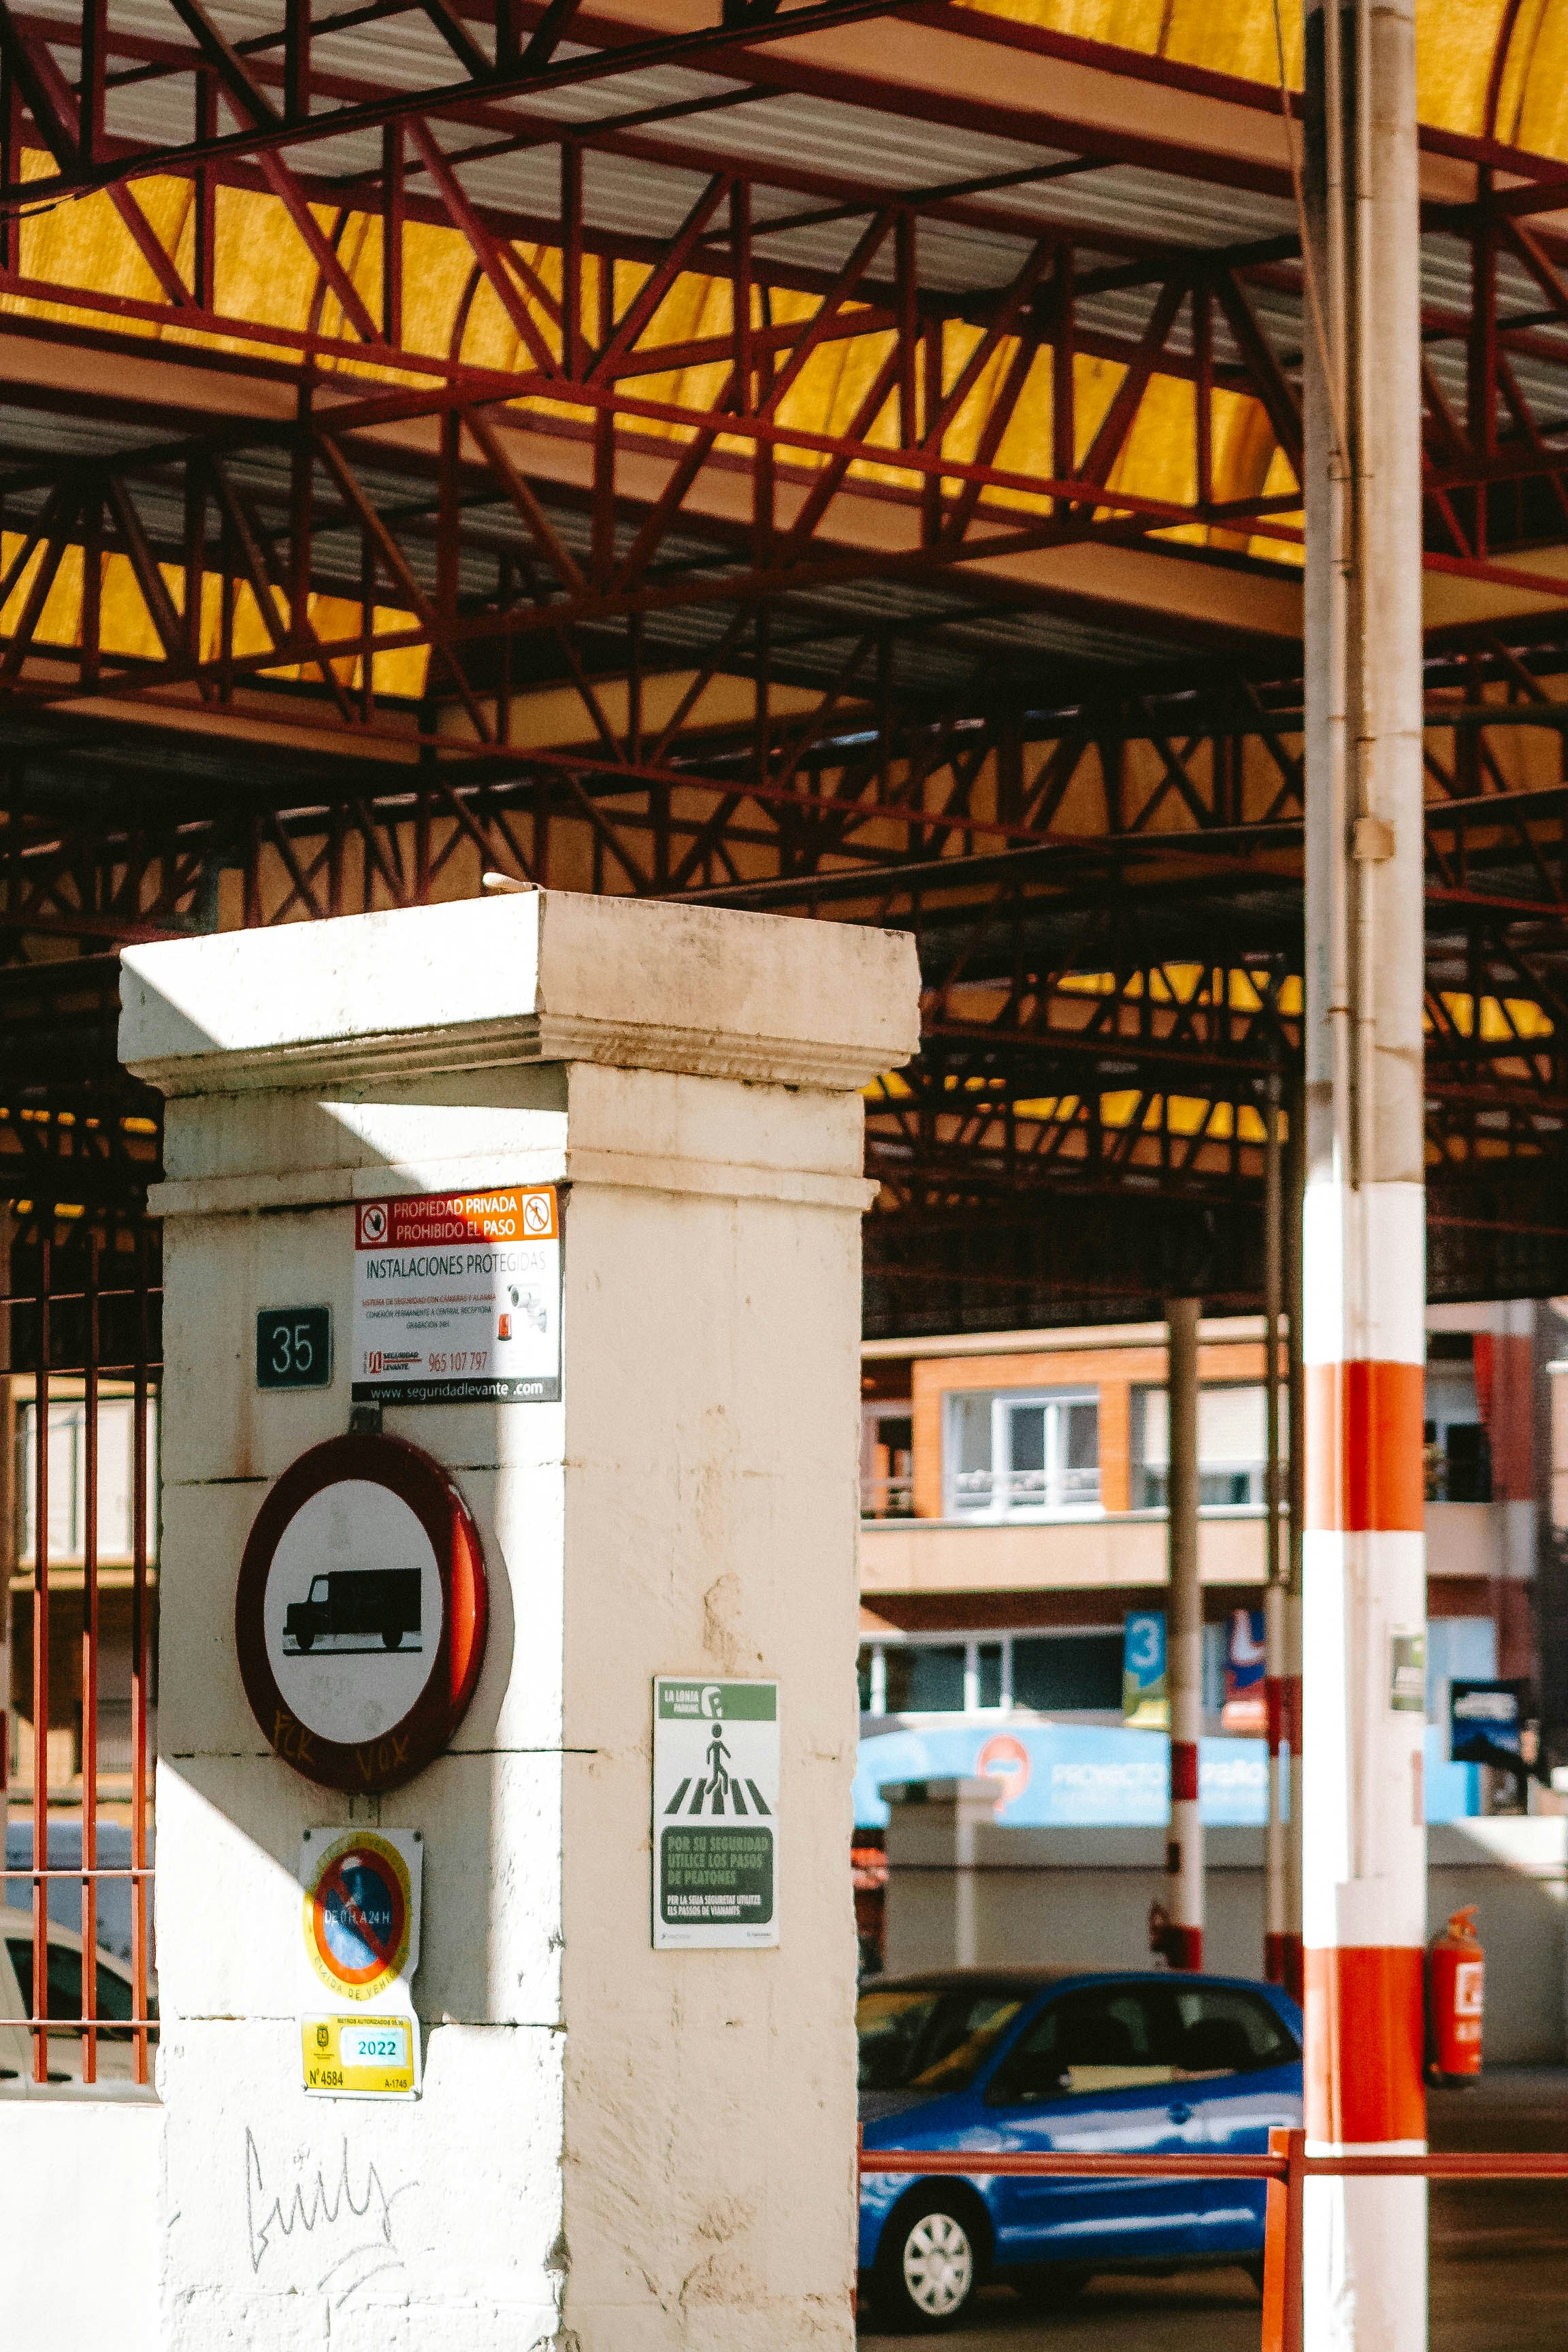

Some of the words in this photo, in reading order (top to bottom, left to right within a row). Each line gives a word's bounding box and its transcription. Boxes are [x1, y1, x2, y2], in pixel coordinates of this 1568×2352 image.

[394, 1199, 463, 1218] PROPIEDAD
[466, 1196, 518, 1214] PRIVADA
[397, 1222, 464, 1240] PROHIBIDO
[467, 1221, 480, 1237] EL
[483, 1218, 516, 1236] PASO
[366, 1255, 463, 1279] INSTALACIONES
[467, 1251, 546, 1274] PROTEGIDAS
[272, 1324, 312, 1373] 35
[383, 1351, 419, 1360] SEGURIDAD
[428, 1352, 447, 1373] 965
[450, 1352, 467, 1372] 107
[470, 1350, 488, 1371] 797
[1132, 1618, 1158, 1668] 3
[664, 1689, 674, 1702] LA
[668, 1836, 690, 1851] POR
[693, 1836, 706, 1851] SU
[710, 1836, 769, 1851] SEGURIDAD
[668, 1852, 705, 1868] UTILICE
[708, 1852, 727, 1868] LOS
[730, 1853, 763, 1868] PASOS
[668, 1869, 681, 1884] DE
[685, 1869, 736, 1885] PEATONES
[667, 1895, 679, 1905] PER
[679, 1895, 687, 1905] LA
[704, 1895, 736, 1905] SEGURETAT
[324, 1910, 338, 1925] DE
[359, 1910, 367, 1924] A
[368, 1910, 380, 1925] 24
[678, 1906, 701, 1916] PASSOS
[314, 1956, 343, 1995] EIXIDA
[348, 1988, 361, 1999] DE
[358, 2041, 396, 2055] 2022
[321, 2071, 344, 2086] 4584
[385, 2079, 408, 2089] A-1745
